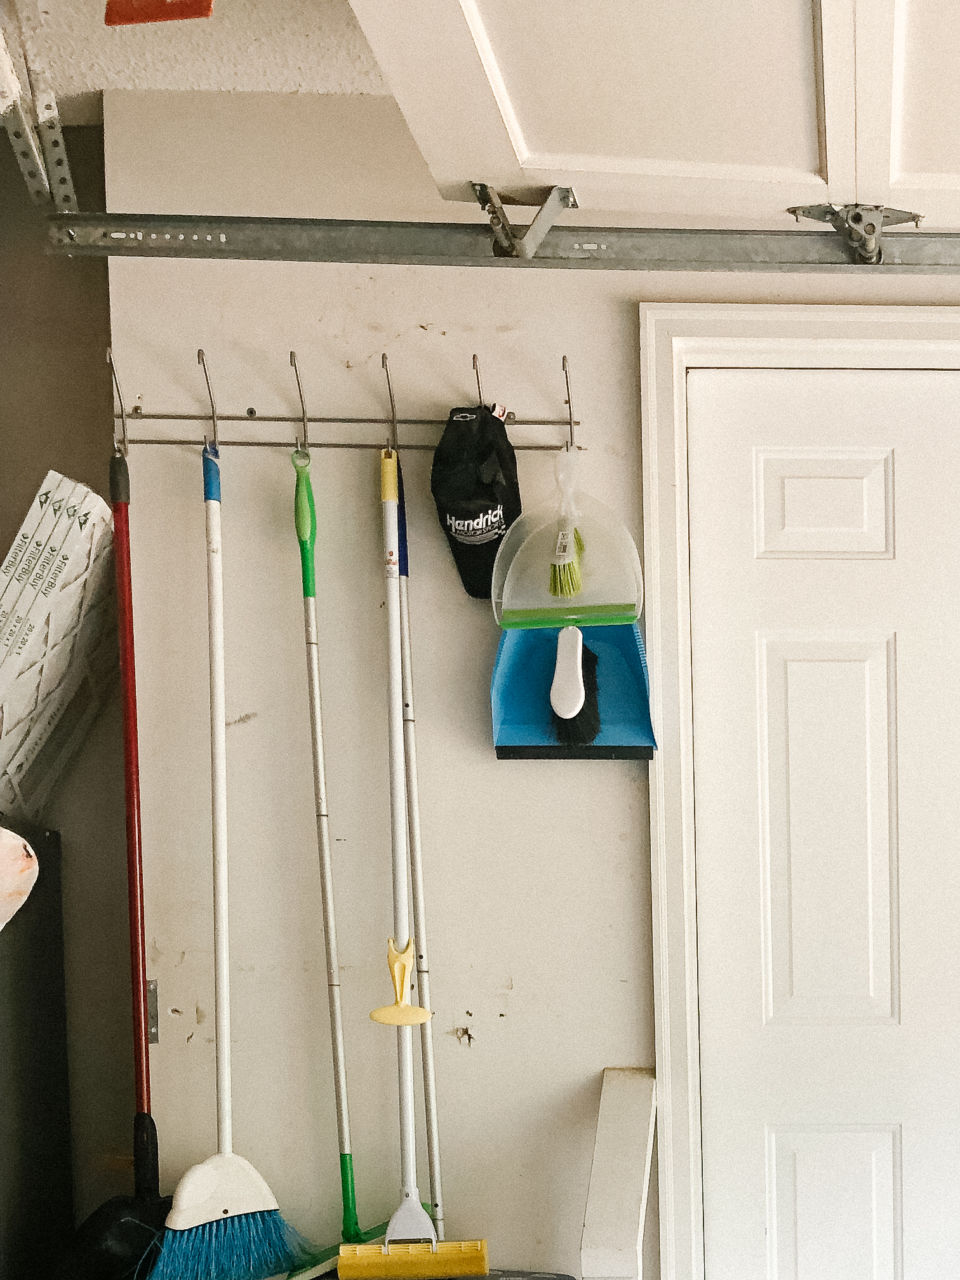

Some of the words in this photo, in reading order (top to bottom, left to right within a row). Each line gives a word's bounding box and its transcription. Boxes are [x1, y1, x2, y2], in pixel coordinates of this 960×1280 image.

[446, 504, 504, 532] Hendrick
[14, 545, 41, 584] FilterBuy
[28, 551, 56, 590] FilterBuy
[40, 560, 67, 598] FilterBuy
